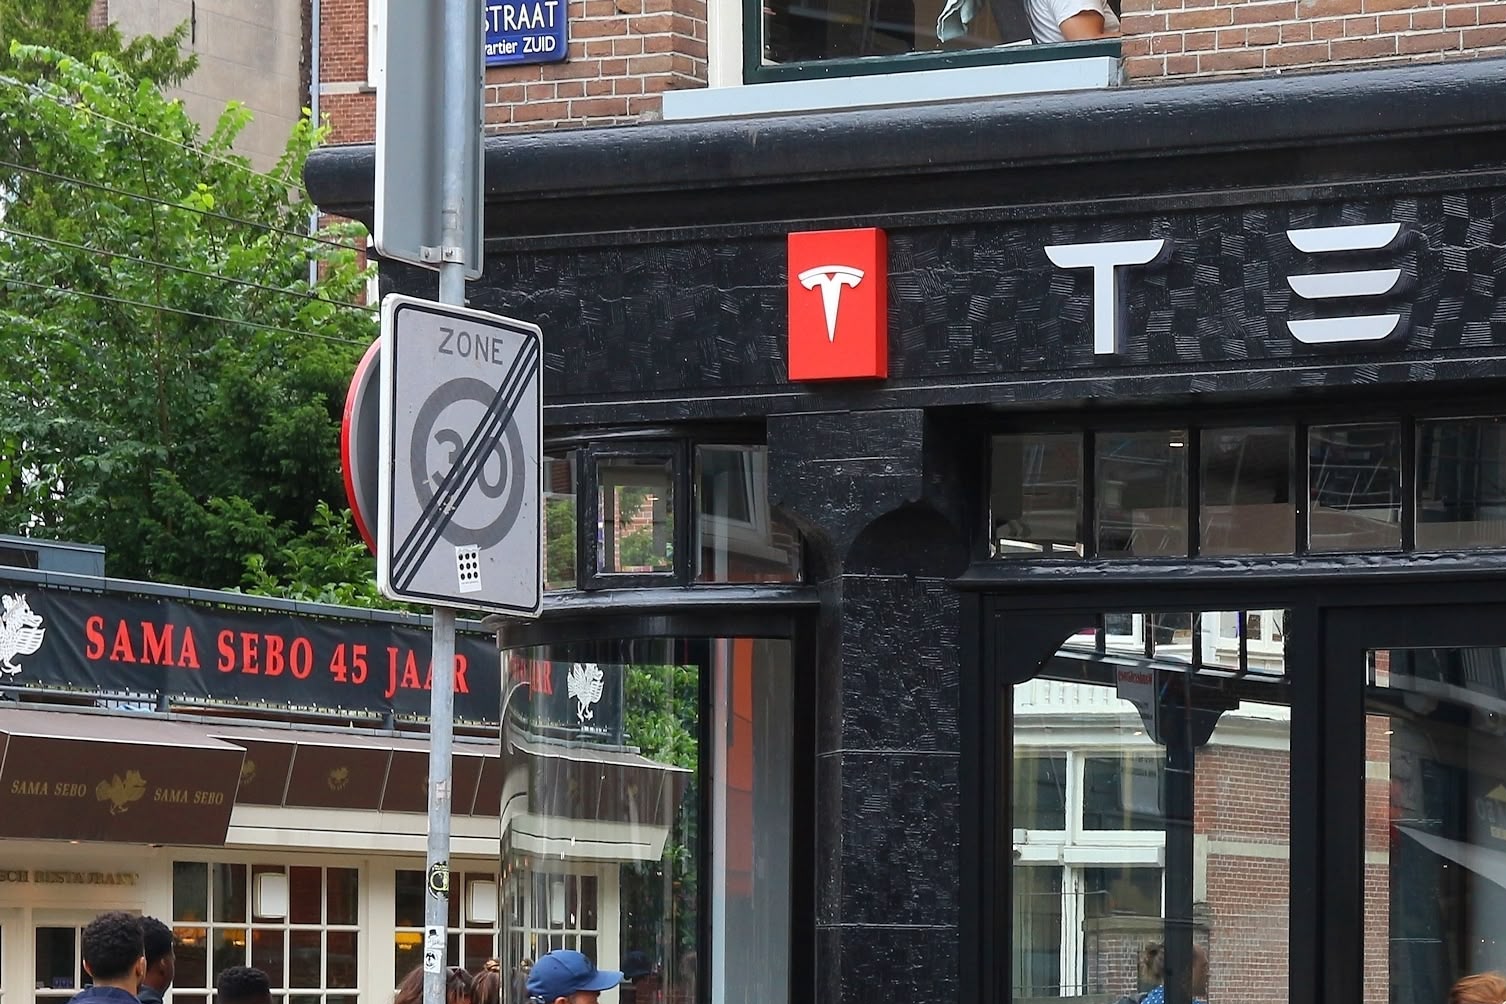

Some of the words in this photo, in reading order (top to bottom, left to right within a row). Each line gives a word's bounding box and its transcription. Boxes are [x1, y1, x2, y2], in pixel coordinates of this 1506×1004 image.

[522, 36, 556, 53] ZUID
[438, 327, 503, 365] ZONE
[432, 428, 508, 499] 30
[85, 615, 200, 669] SAMA
[217, 630, 313, 680] SEBO
[329, 643, 368, 684] 45
[384, 647, 469, 699] JAR
[11, 780, 48, 796] SAMA
[54, 782, 87, 798] SEBO
[153, 787, 188, 804] SAMA
[193, 790, 224, 806] SEBO
